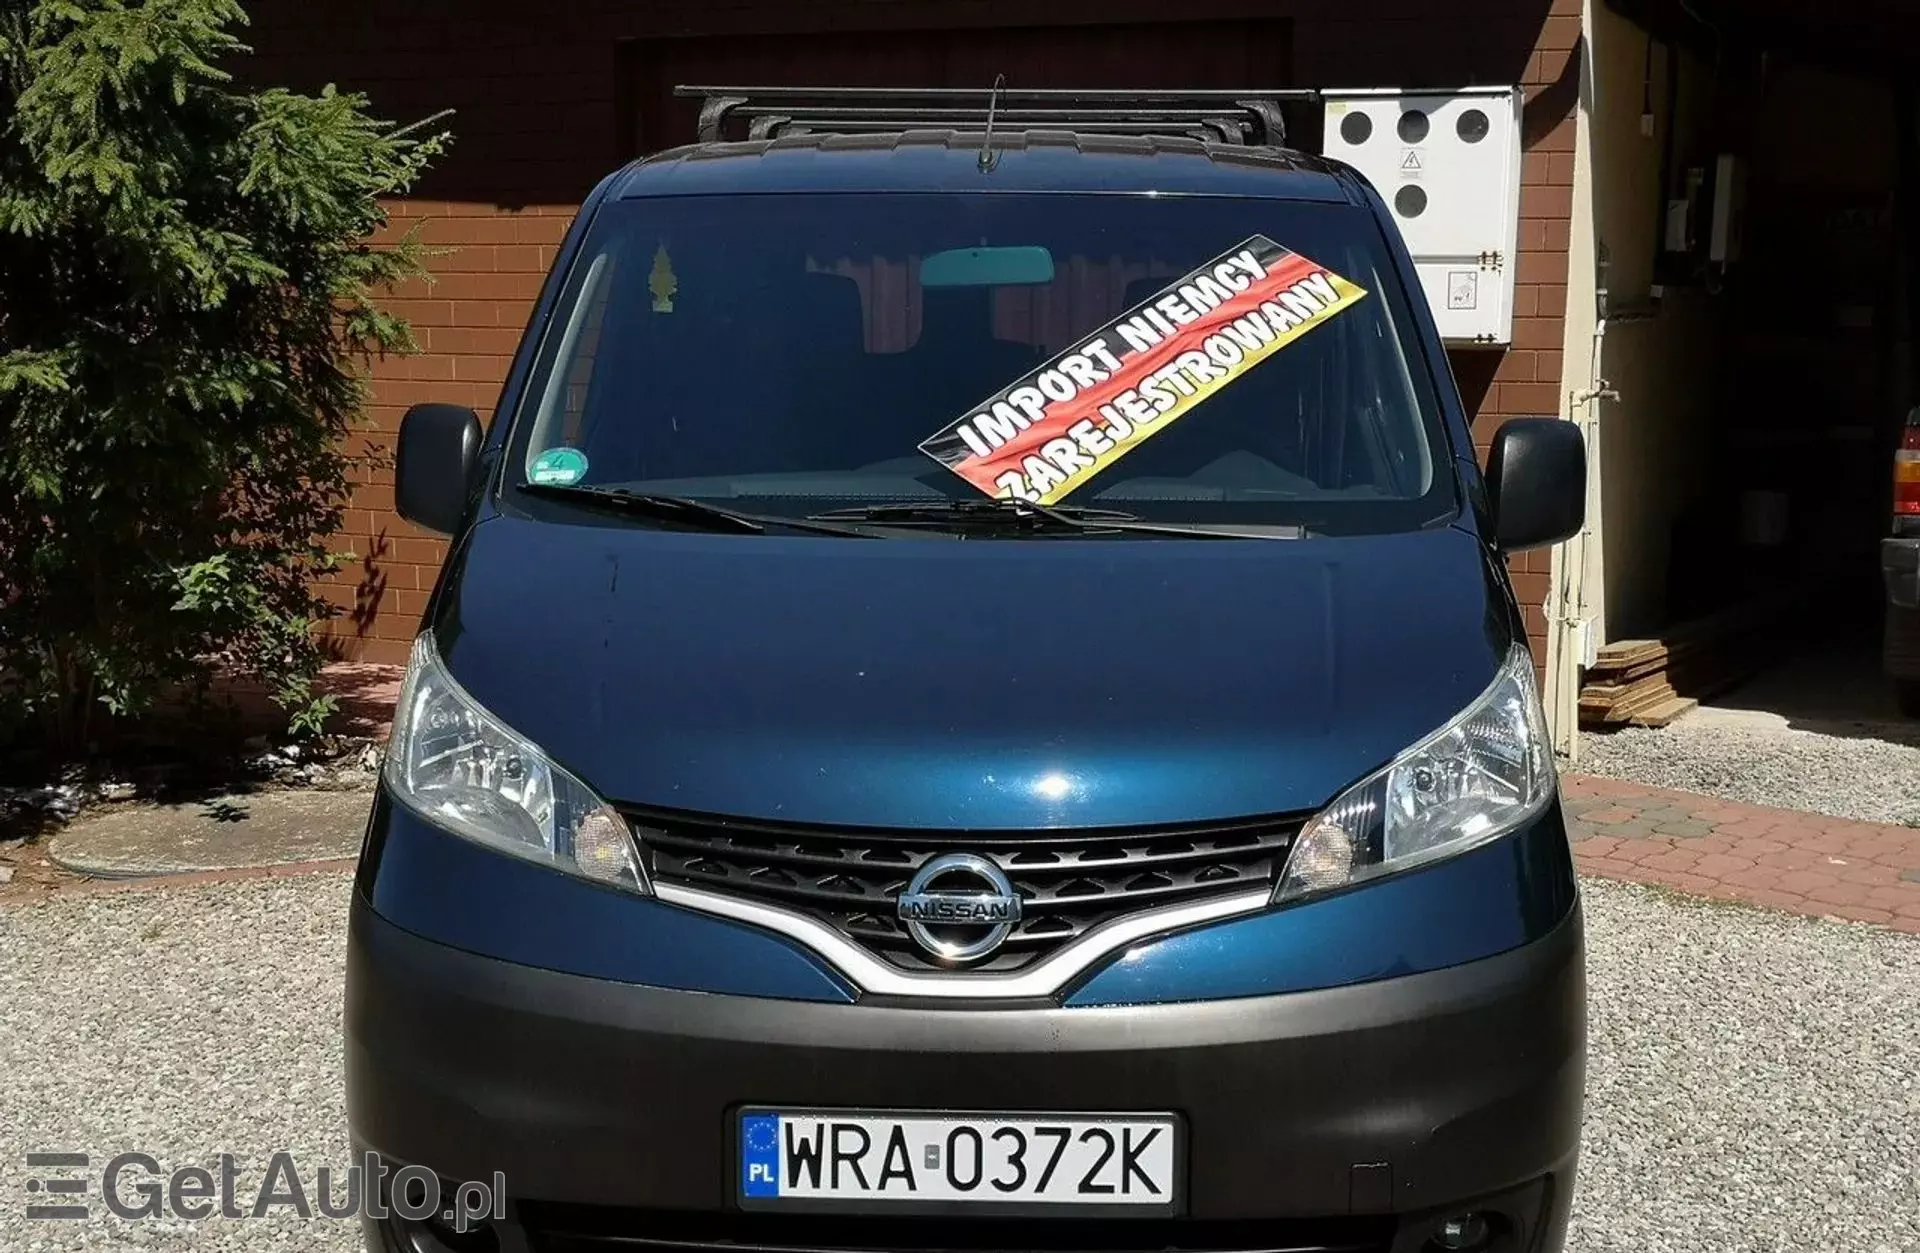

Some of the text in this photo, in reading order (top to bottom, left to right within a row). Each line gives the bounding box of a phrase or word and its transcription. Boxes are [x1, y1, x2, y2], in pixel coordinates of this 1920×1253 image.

[956, 250, 1270, 458] IMPORT NIEMCY
[993, 271, 1341, 516] ZAREJESTROWANY
[547, 453, 565, 470] 4
[911, 901, 1008, 918] NISSAN
[748, 1163, 775, 1182] PL
[784, 1121, 1165, 1195] WRA 0372K
